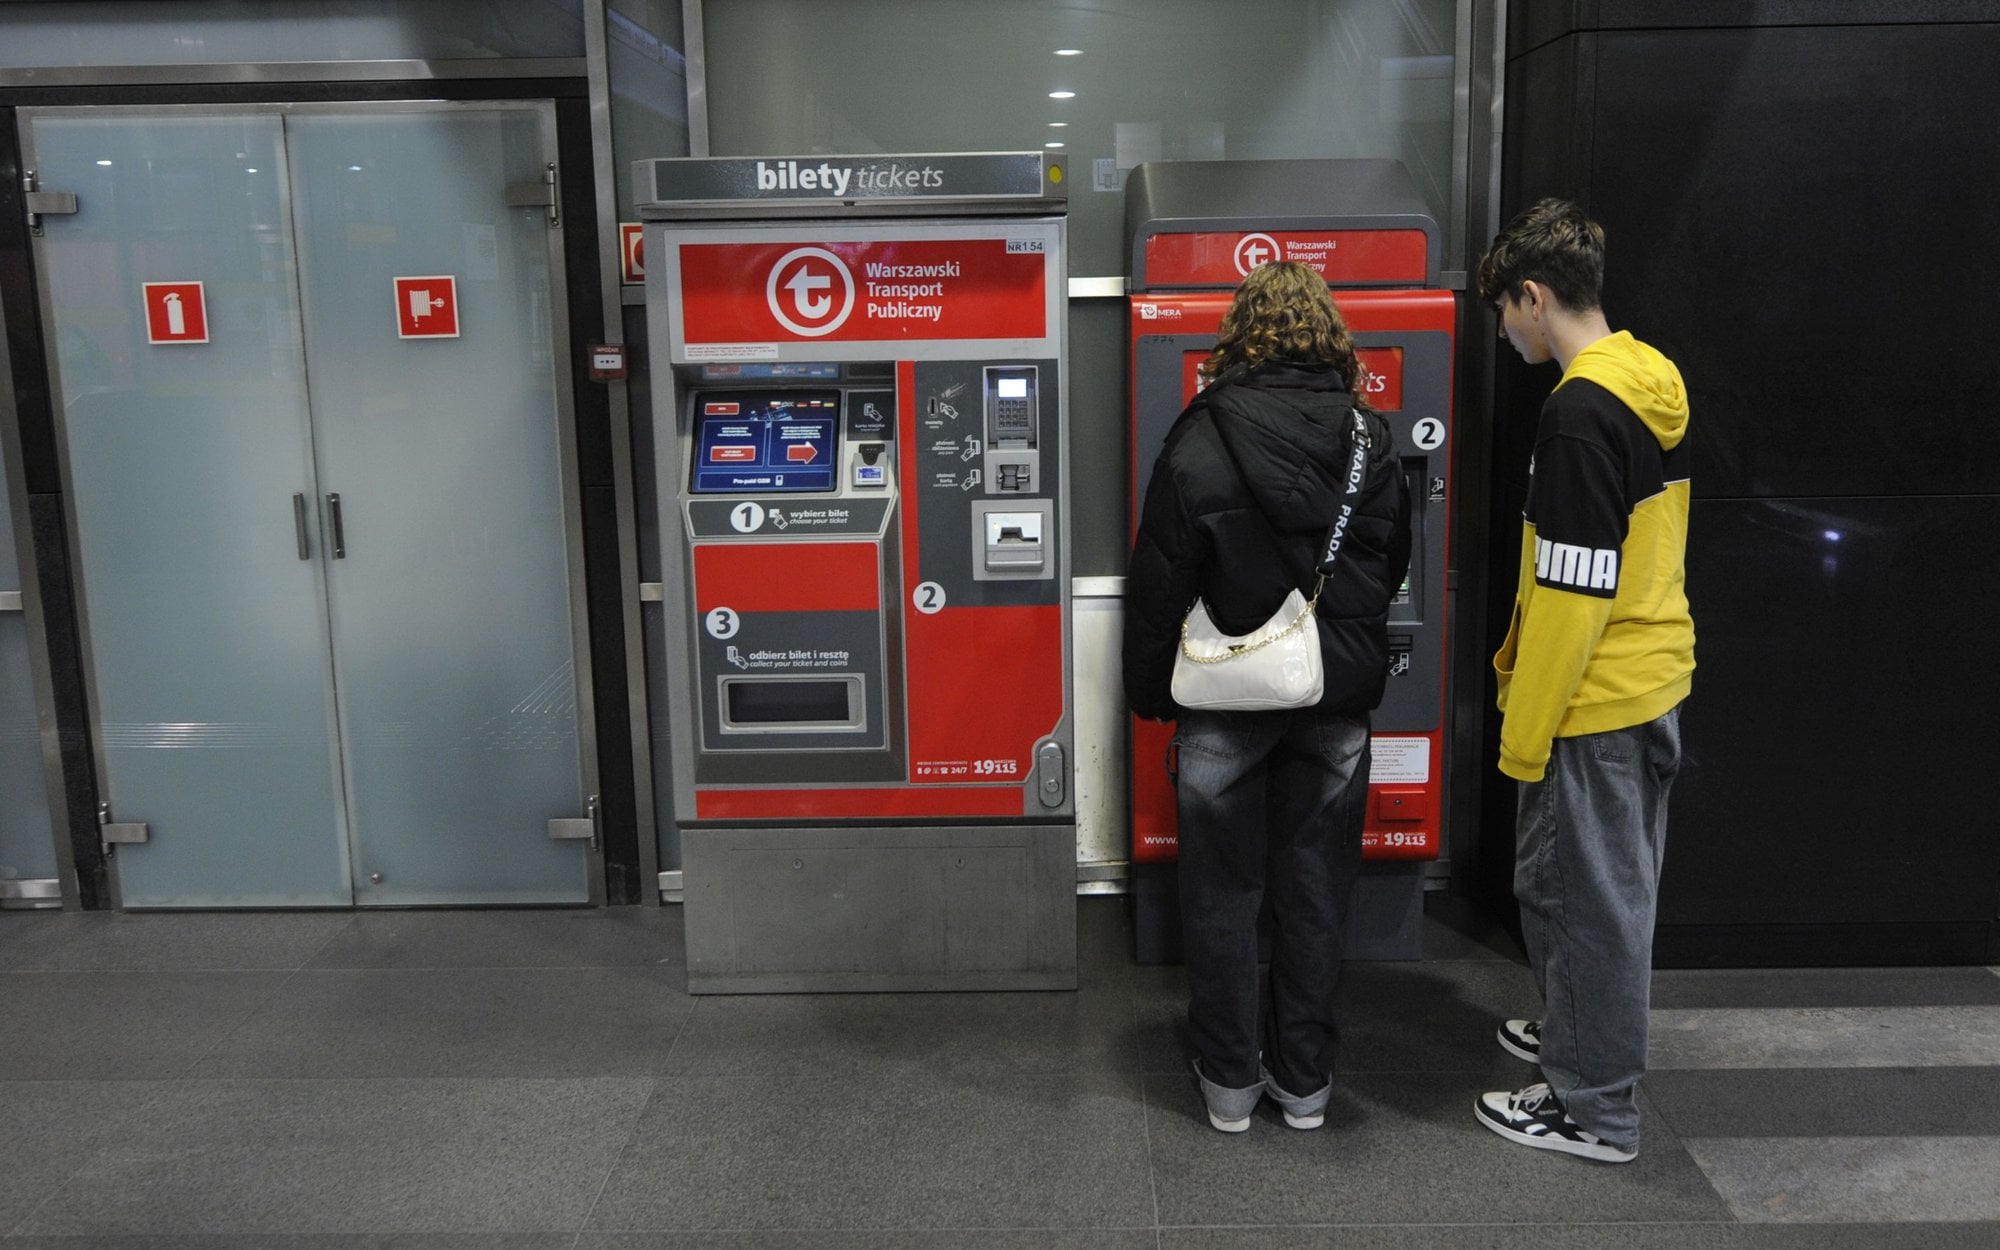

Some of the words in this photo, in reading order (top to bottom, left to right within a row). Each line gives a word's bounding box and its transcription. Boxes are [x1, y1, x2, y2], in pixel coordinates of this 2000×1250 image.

[757, 161, 852, 196] bilety
[857, 164, 944, 188] tickets
[1286, 240, 1336, 250] Warszawski
[1286, 251, 1326, 261] Transport
[865, 261, 960, 278] Warszawski
[866, 282, 943, 300] Transport
[867, 303, 942, 322] Publiczny
[1422, 422, 1436, 444] 2
[741, 506, 752, 528] 1
[790, 509, 826, 518] wybierz
[828, 509, 849, 517] bilet
[1325, 504, 1351, 562] PRADA
[1536, 535, 1617, 589] UMA
[922, 586, 937, 608] 2
[716, 611, 731, 634] 3
[749, 651, 787, 660] odbierz
[789, 650, 811, 659] bilet
[819, 650, 849, 661] resztę
